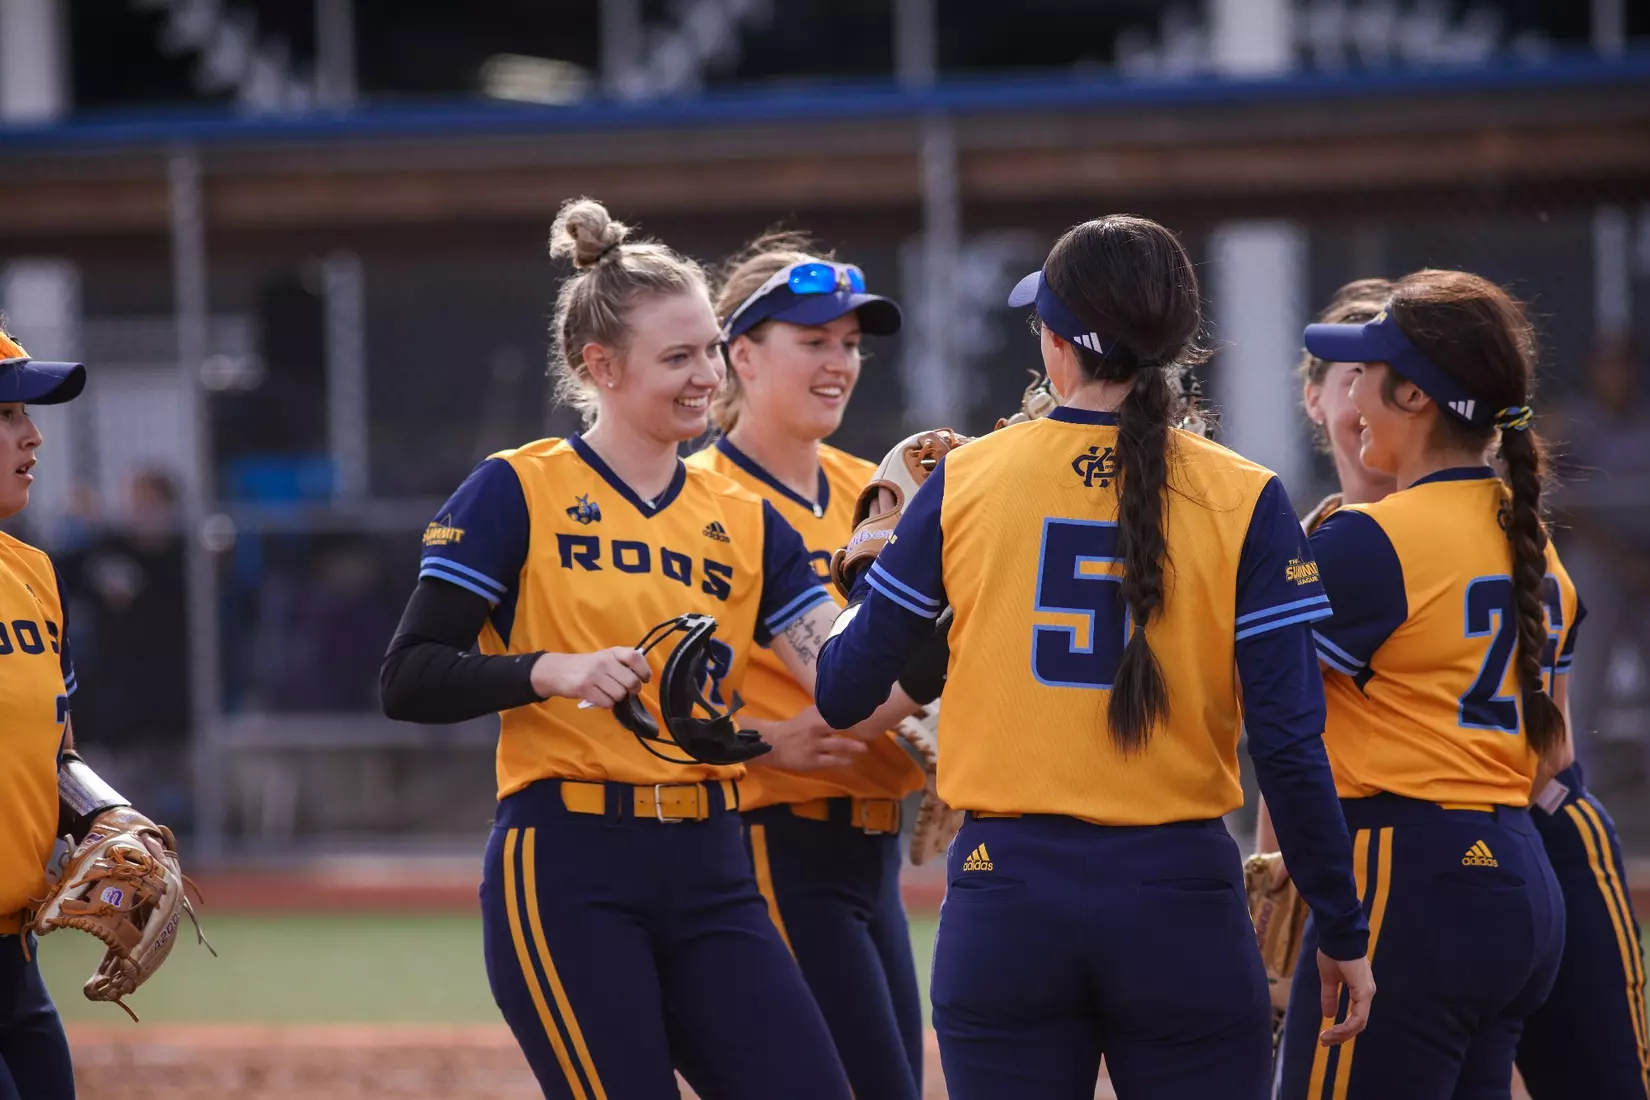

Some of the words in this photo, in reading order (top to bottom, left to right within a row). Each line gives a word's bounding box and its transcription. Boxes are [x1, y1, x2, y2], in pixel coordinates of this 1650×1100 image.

[555, 533, 733, 601] ROOS
[1031, 516, 1134, 690] 5
[961, 860, 994, 872] adidas
[1461, 856, 1499, 868] adidas
[153, 911, 180, 951] A200
